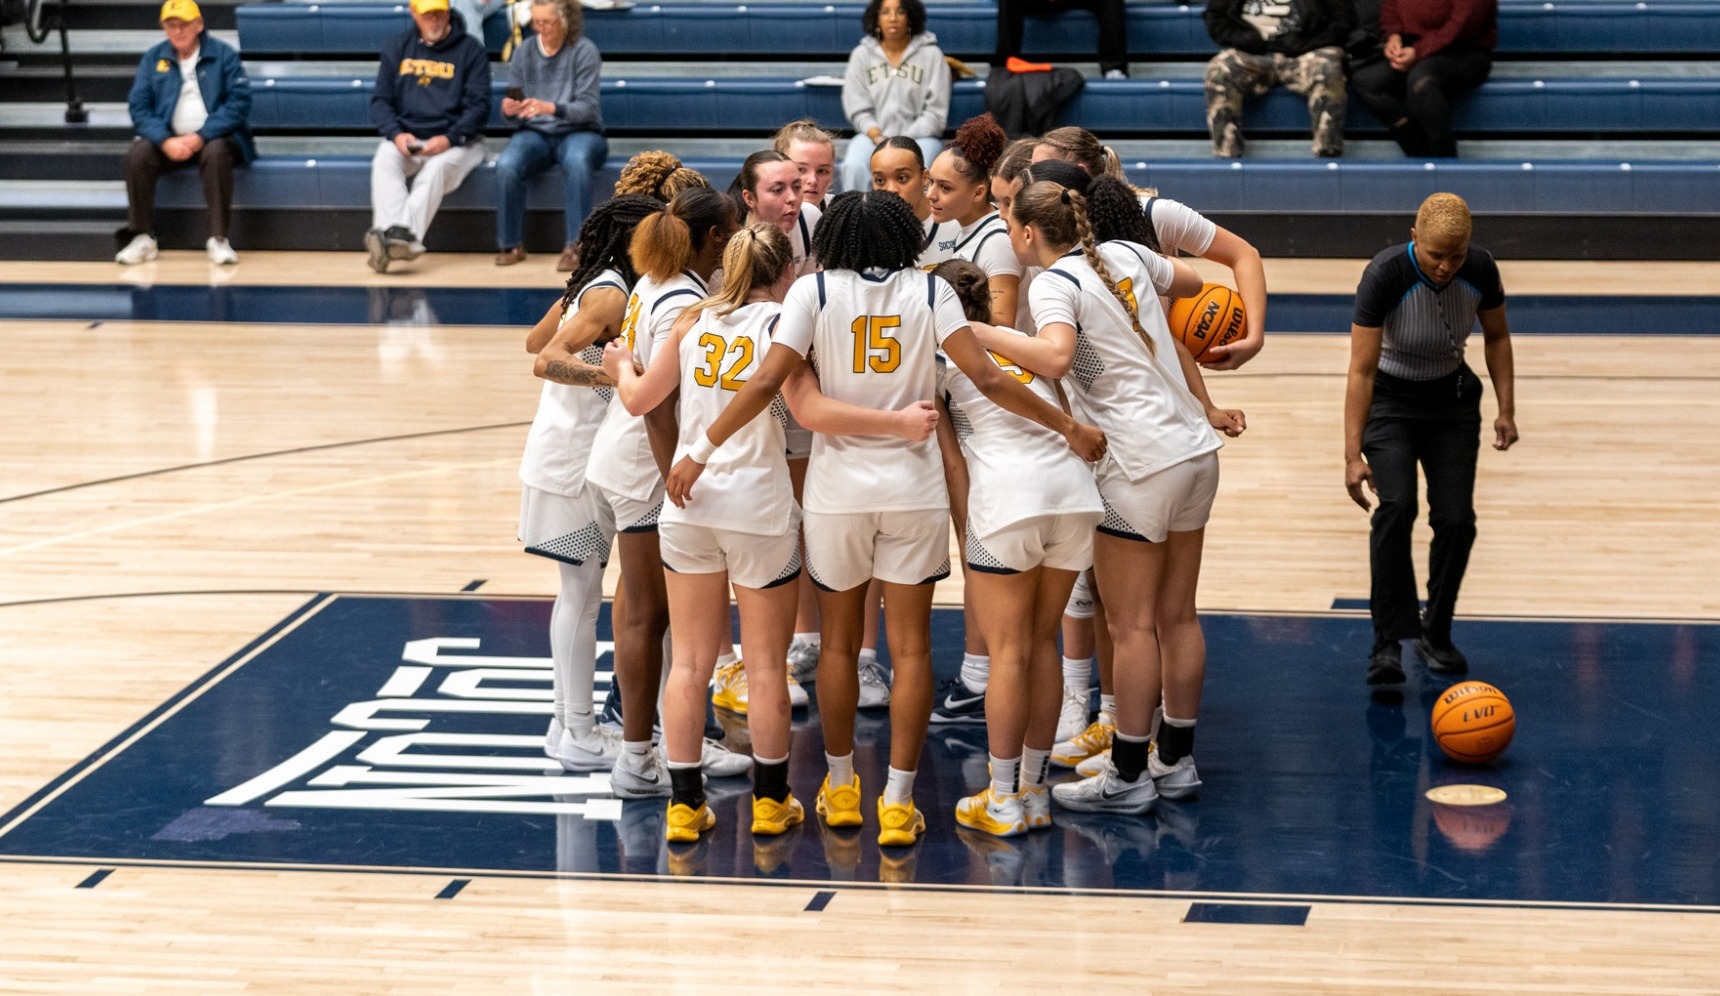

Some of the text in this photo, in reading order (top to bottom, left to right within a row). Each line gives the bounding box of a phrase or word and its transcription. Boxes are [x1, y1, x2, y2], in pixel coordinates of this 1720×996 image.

[867, 62, 924, 86] ETSU
[1193, 300, 1221, 339] NCAA
[694, 332, 755, 392] 32
[851, 315, 902, 373] 15
